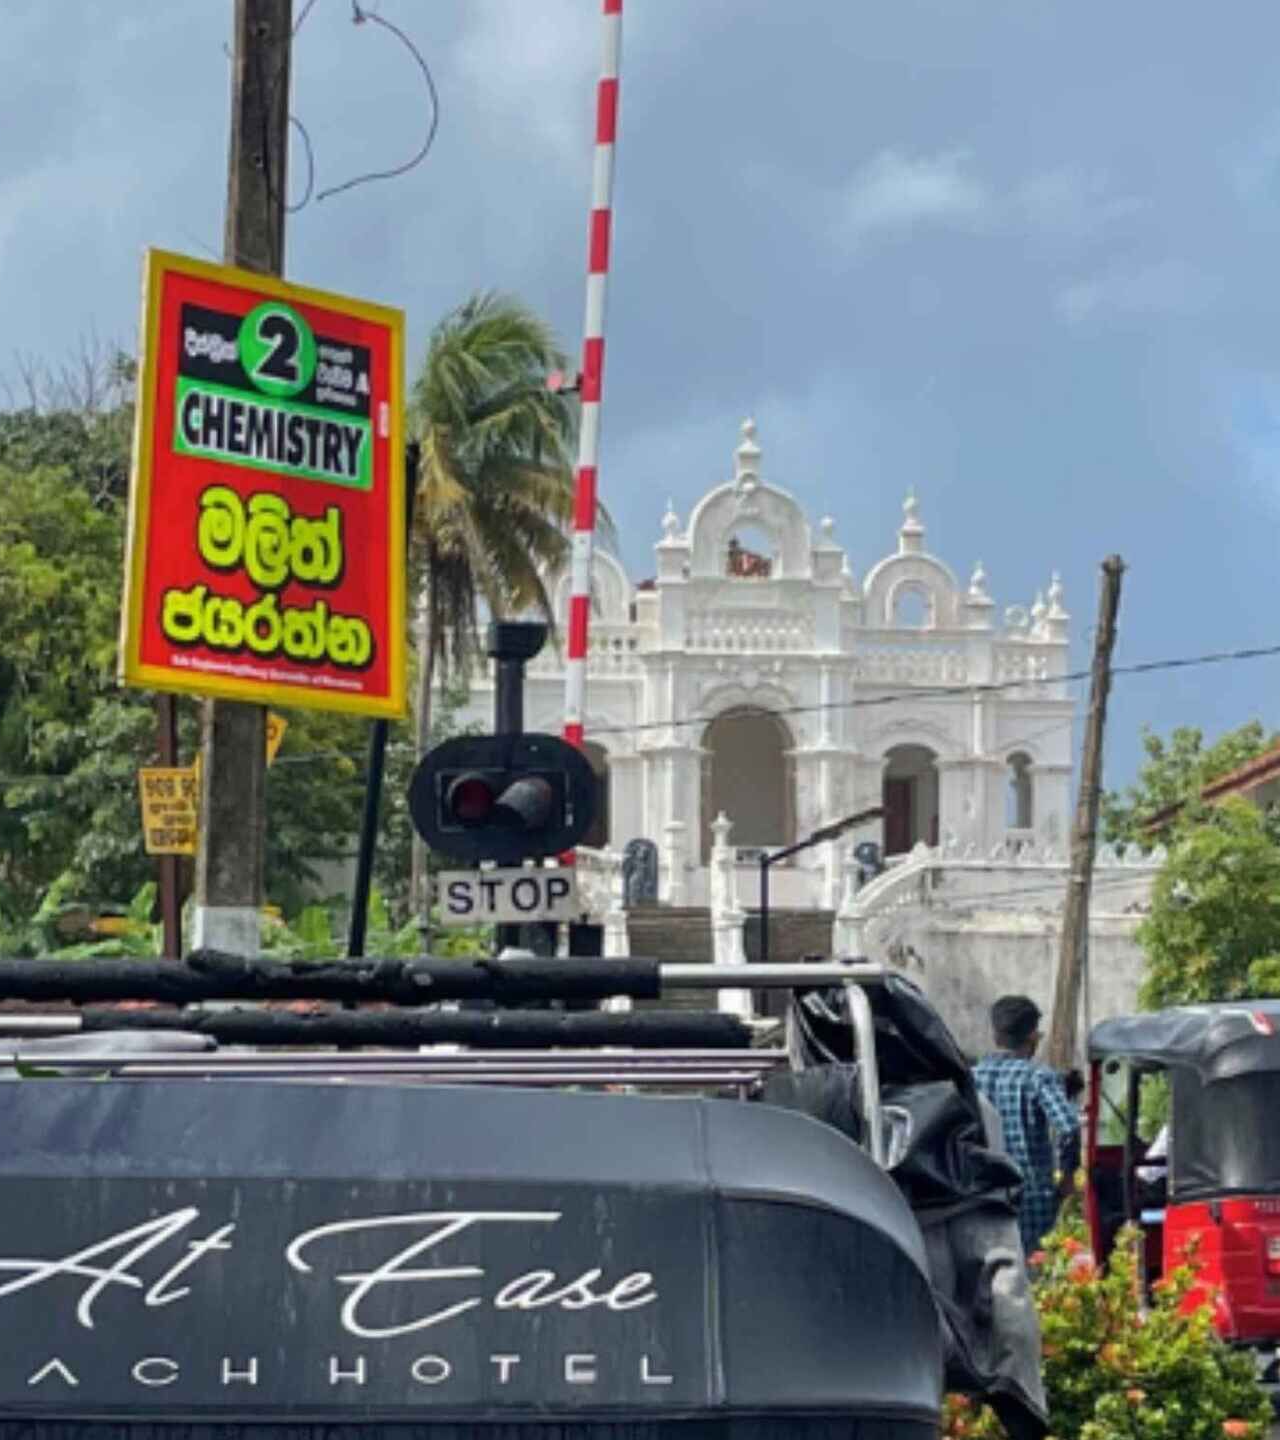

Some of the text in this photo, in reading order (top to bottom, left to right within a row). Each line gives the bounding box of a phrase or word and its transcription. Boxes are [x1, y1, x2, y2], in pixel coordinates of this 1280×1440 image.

[256, 310, 301, 384] 2
[180, 388, 365, 479] CHEMISTRY
[198, 486, 342, 587] මලිත්
[163, 585, 371, 666] ජයරත්න
[447, 877, 571, 914] STOP
[286, 1210, 660, 1339] Ease
[329, 1354, 673, 1386] HOTEL
